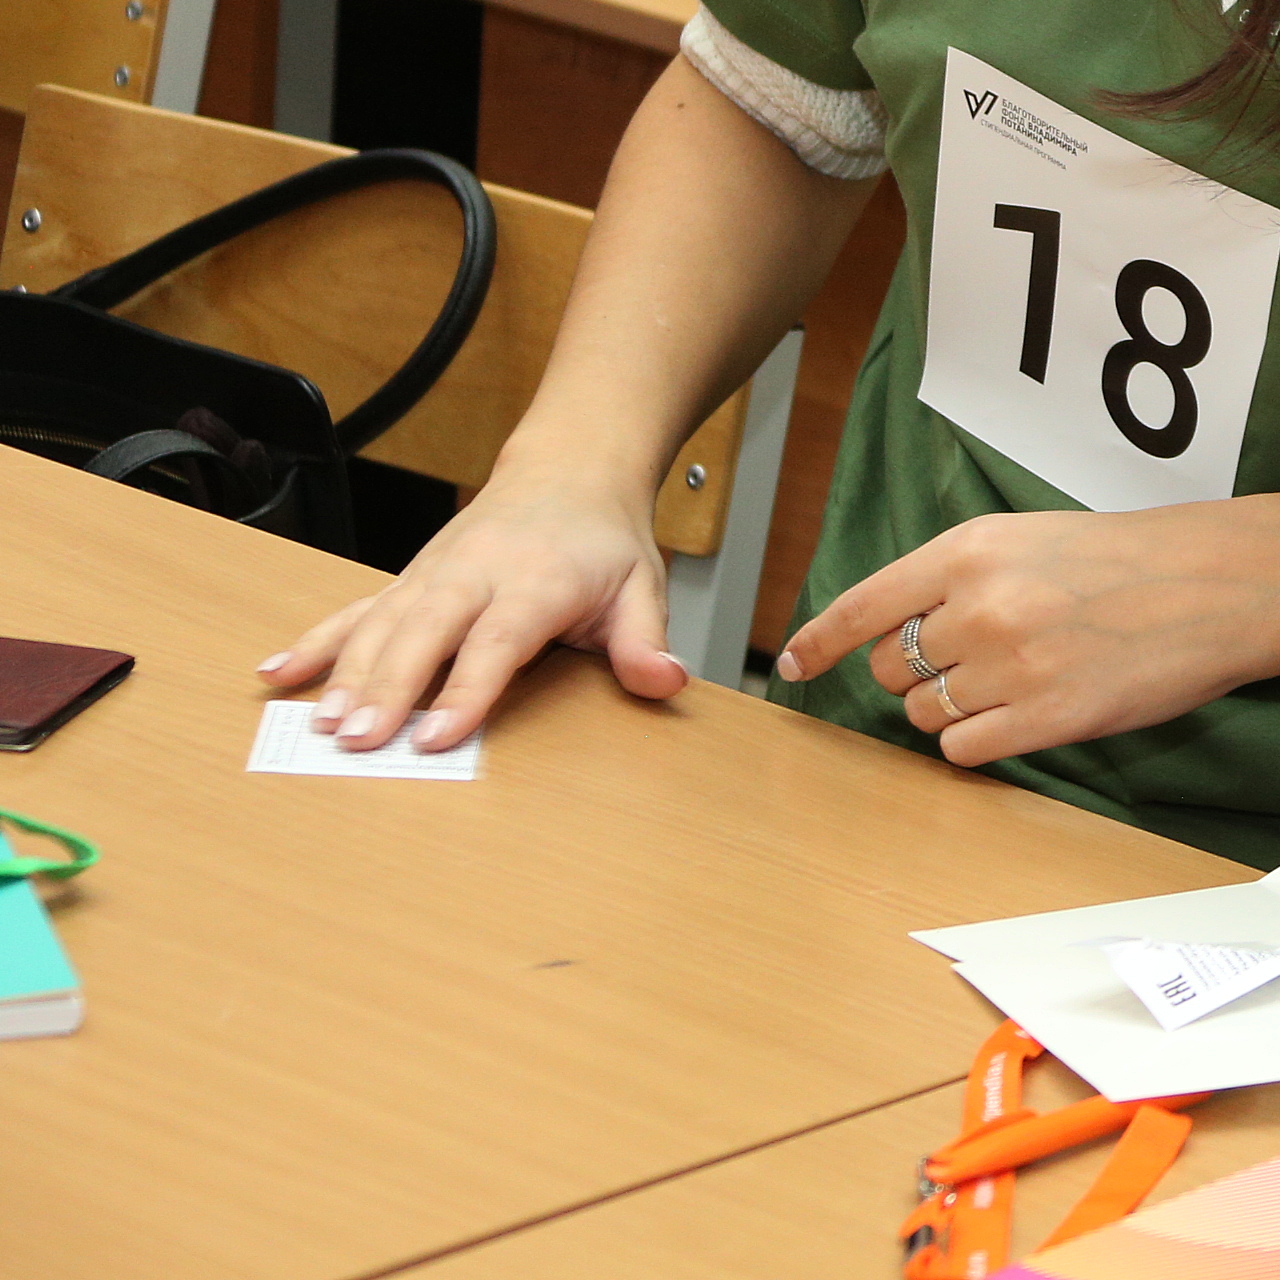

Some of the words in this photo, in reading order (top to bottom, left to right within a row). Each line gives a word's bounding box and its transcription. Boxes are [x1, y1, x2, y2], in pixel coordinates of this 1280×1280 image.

[1001, 116, 1044, 146] ПОТАНИНА
[1001, 108, 1025, 126] ФОНД
[1028, 121, 1077, 156] ВЛАДИМИРА
[1002, 99, 1088, 153] БЛАГОТВОРИТЕЛЬНЫЙ
[993, 203, 1212, 459] 18
